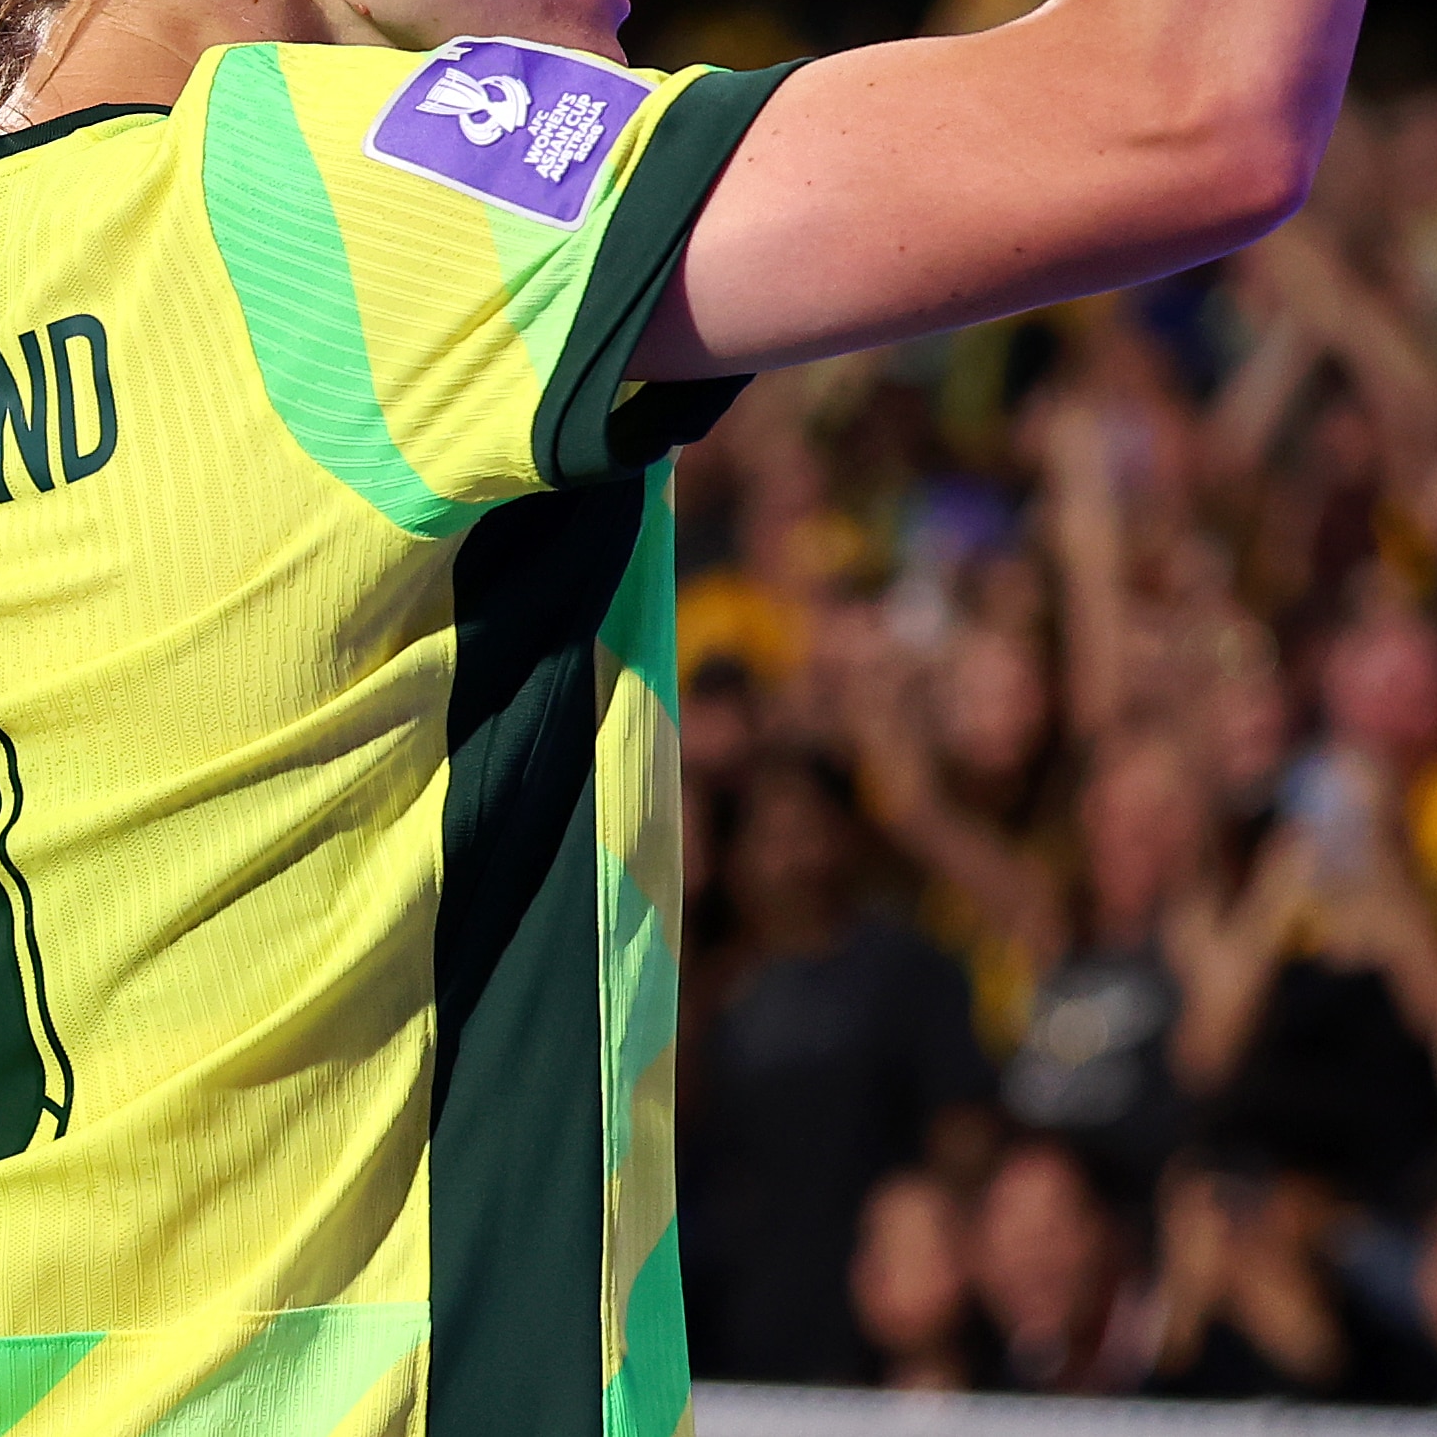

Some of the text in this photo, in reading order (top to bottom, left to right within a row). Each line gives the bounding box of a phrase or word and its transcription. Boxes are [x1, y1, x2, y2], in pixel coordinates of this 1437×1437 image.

[527, 109, 550, 136] AFC
[535, 93, 592, 179] ASIAN CUP
[549, 101, 608, 183] AUSTRALIA
[573, 124, 605, 162] 2026
